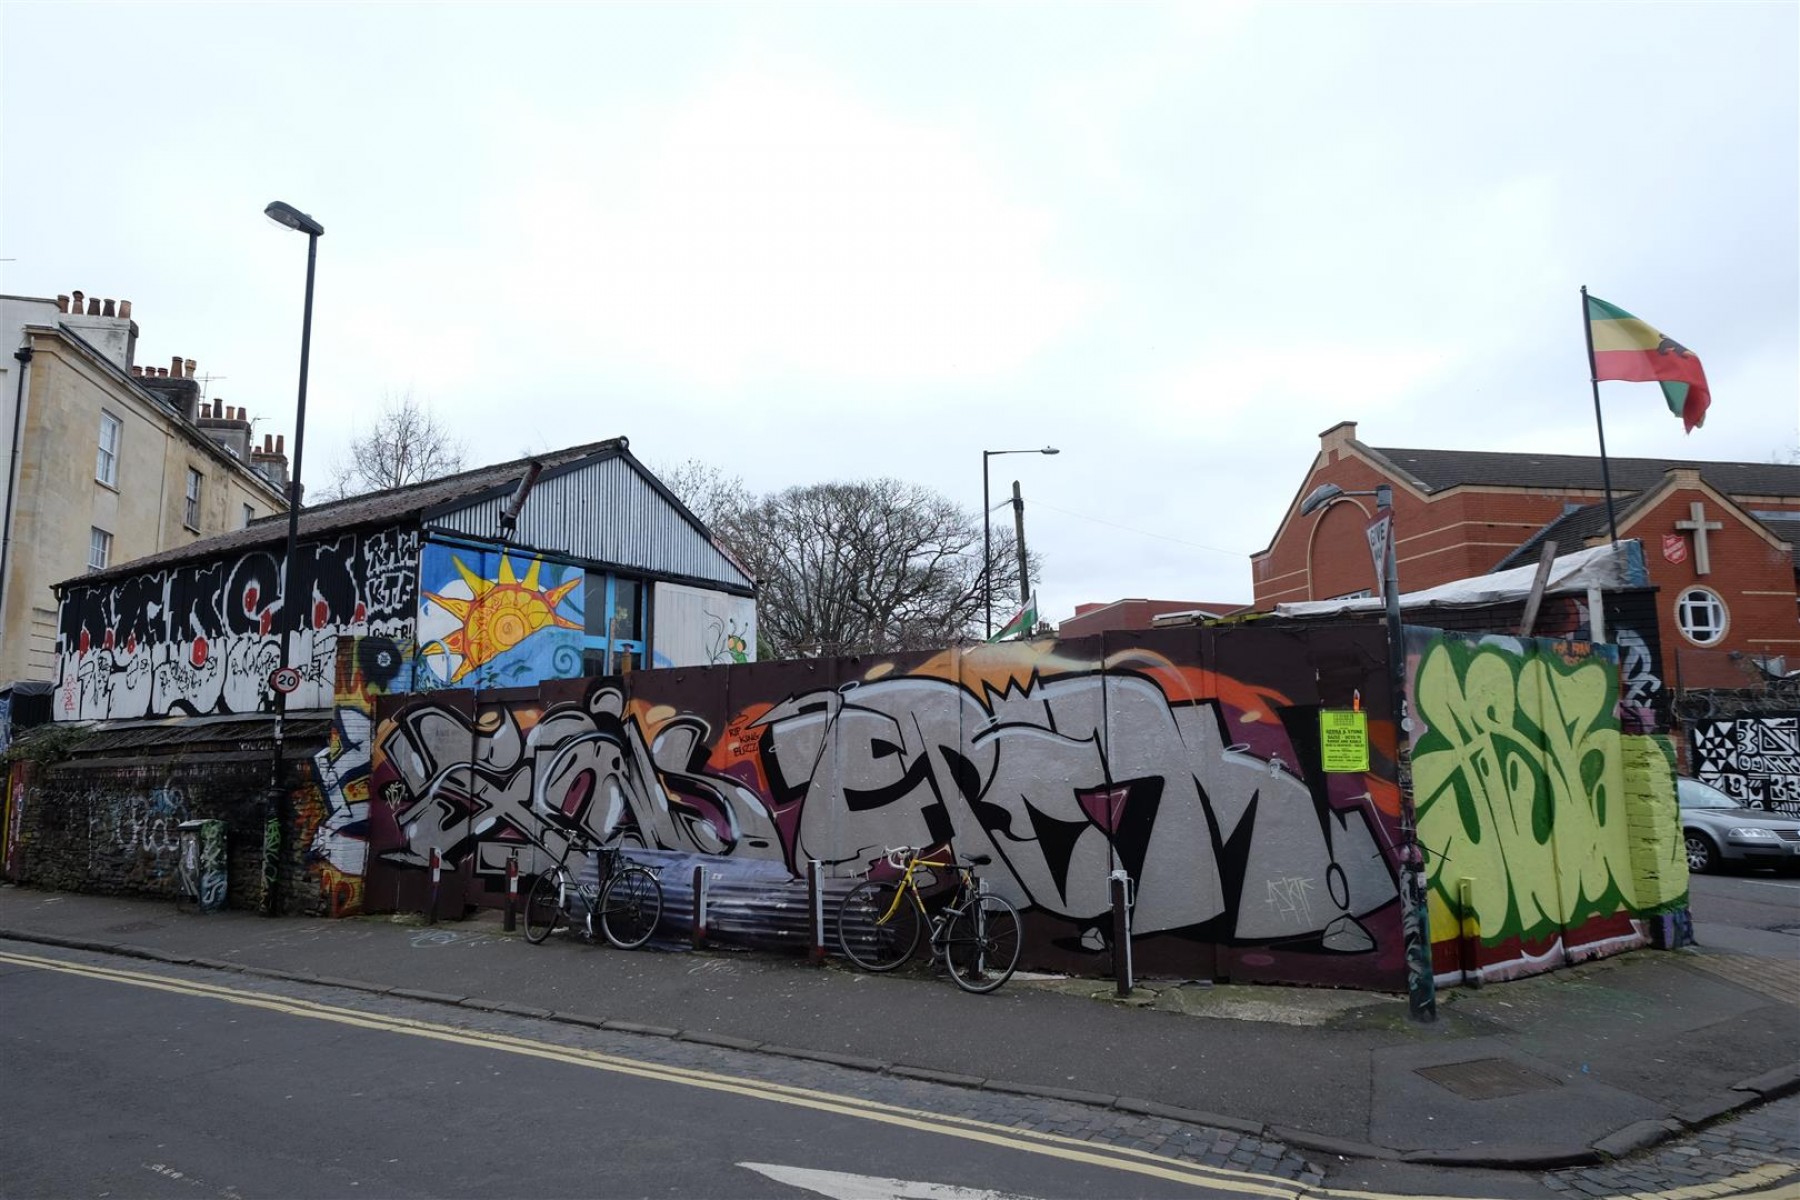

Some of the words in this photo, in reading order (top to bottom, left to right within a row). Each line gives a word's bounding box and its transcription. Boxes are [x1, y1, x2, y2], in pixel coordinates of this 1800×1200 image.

[1370, 522, 1385, 547] GIVE
[278, 674, 297, 687] 20
[729, 727, 741, 737] RIP
